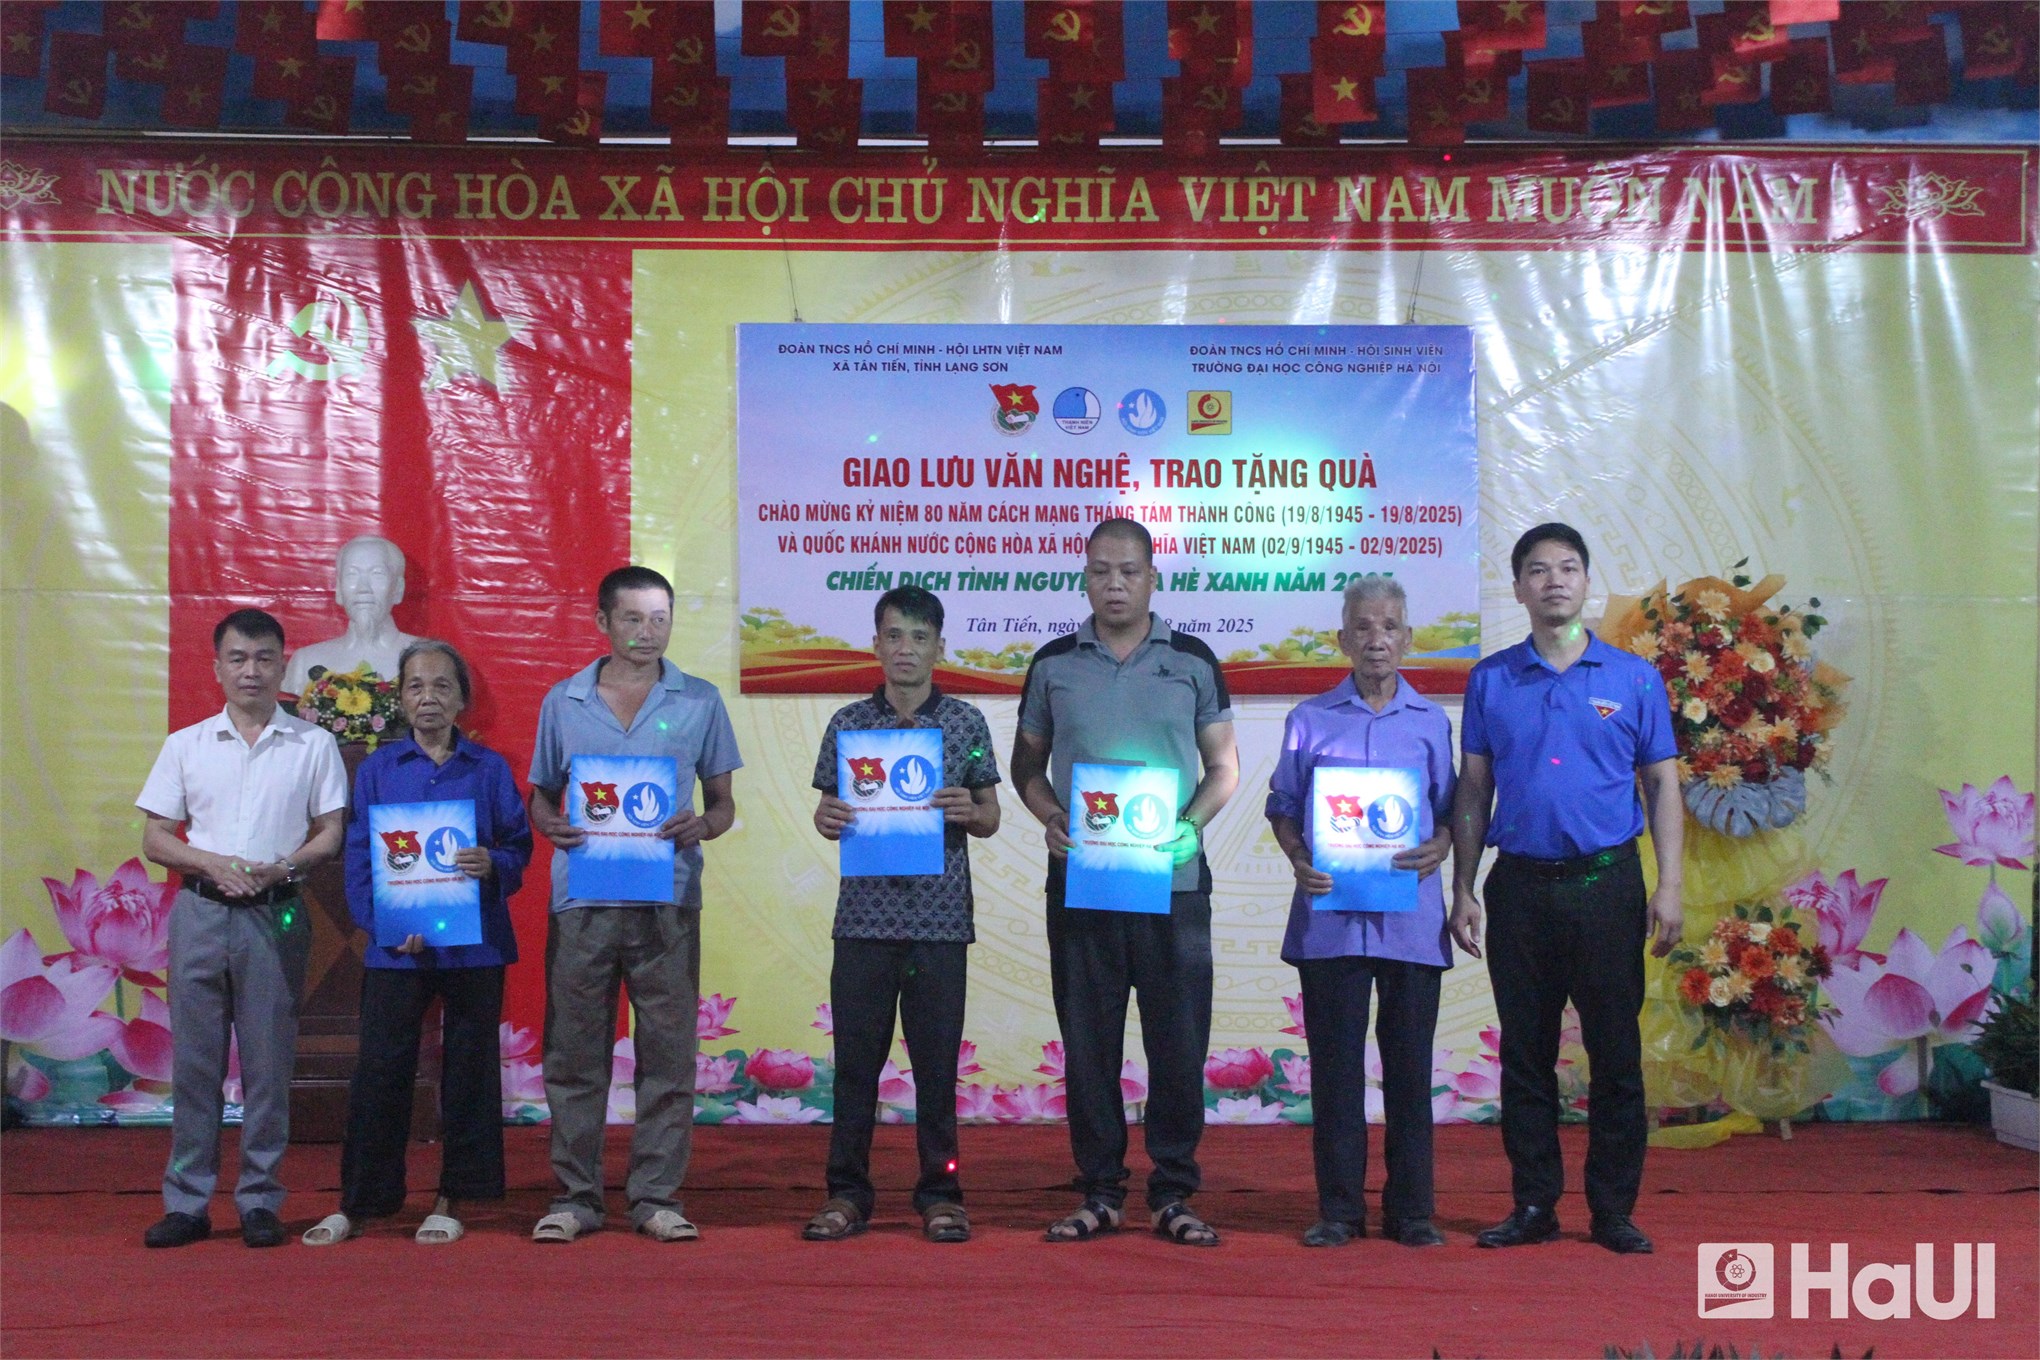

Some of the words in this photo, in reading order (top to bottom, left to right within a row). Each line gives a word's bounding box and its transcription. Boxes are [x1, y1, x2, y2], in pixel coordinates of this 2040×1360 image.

[97, 155, 256, 217] NƯỚC
[272, 156, 437, 220] CÔNG
[453, 158, 579, 221] HÒA
[600, 166, 684, 222] XÃ
[703, 161, 809, 235] HỘI
[828, 156, 947, 224] CHỦ
[966, 166, 1160, 224] NGHĨA
[1178, 161, 1316, 236] VIỆT
[1332, 176, 1471, 224] NAM
[1487, 160, 1665, 224] MUÔN
[1682, 163, 1818, 224] NĂM
[778, 342, 815, 355] ĐOÀN
[819, 344, 850, 355] TNCS
[877, 342, 899, 355] CHÍ
[903, 344, 935, 355] MINH
[946, 342, 968, 358] HỘI
[973, 345, 1002, 355] LHTN
[1006, 342, 1031, 358] VIỆT
[1034, 345, 1063, 355] NAM
[1190, 342, 1227, 356] ĐOÀN
[1230, 345, 1262, 356] TNCS
[1288, 343, 1311, 356] CHÍ
[1314, 345, 1346, 356] MINH
[1357, 343, 1380, 358] HỘI
[1383, 346, 1412, 356] SINH
[1416, 343, 1443, 356] VIÊN
[833, 359, 851, 372] XÃ
[854, 359, 878, 372] TÂN
[882, 357, 910, 374] TIẾN,
[946, 361, 979, 375] LẠNG
[983, 361, 1009, 373] SƠN
[1192, 359, 1243, 374] TRƯỜNG
[1247, 362, 1269, 376] ĐẠI
[1273, 362, 1301, 376] HỌC
[1305, 360, 1344, 374] CÔNG
[1348, 360, 1393, 376] NGHIỆP
[1397, 359, 1414, 374] HÀ
[1418, 360, 1441, 376] NỘI
[843, 457, 910, 488] GIAO
[921, 455, 974, 488] LƯU
[985, 452, 1043, 488] VĂN
[1054, 453, 1140, 495] NGHỆ,
[1150, 459, 1222, 488] TRAO
[1232, 453, 1308, 495] TẶNG
[1319, 453, 1377, 490] QUÀ
[759, 500, 800, 522] CHÀO
[806, 500, 851, 522] MỪNG
[857, 499, 875, 522] KỶ
[880, 501, 918, 526] NIỆM
[925, 505, 943, 522] 80
[949, 501, 982, 523] NĂM
[988, 500, 1029, 523] CÁCH
[1035, 505, 1080, 526] MẠNG
[1085, 501, 1135, 522] THÁNG
[1140, 501, 1172, 522] TÁM
[1178, 501, 1228, 523] THÀNH
[1235, 501, 1275, 523] CÔNG
[1281, 505, 1363, 527] (19/8/1945
[1381, 505, 1462, 527] 19/8/2025)
[778, 531, 798, 553] VÀ
[803, 530, 844, 555] QUỐC
[851, 532, 902, 554] KHÁNH
[908, 531, 949, 554] NƯỚC
[955, 532, 997, 558] CỘNG
[1002, 532, 1034, 554] HÒA
[1038, 532, 1057, 554] XÃ
[1153, 533, 1179, 554] HĨA
[1184, 532, 1217, 558] VIỆT
[1222, 537, 1256, 554] NAM
[1262, 537, 1343, 558] (02/9/1945
[1361, 536, 1443, 558] 02/9/2025)
[826, 561, 893, 591] CHIẾN
[957, 565, 1010, 592] TÌNH
[1170, 566, 1201, 592] HÈ
[1204, 571, 1270, 592] XANH
[1274, 566, 1326, 592] NĂM
[966, 617, 997, 633] Tân
[1003, 615, 1042, 635] Tiến,
[1177, 618, 1211, 633] năm
[1216, 617, 1254, 633] 2025
